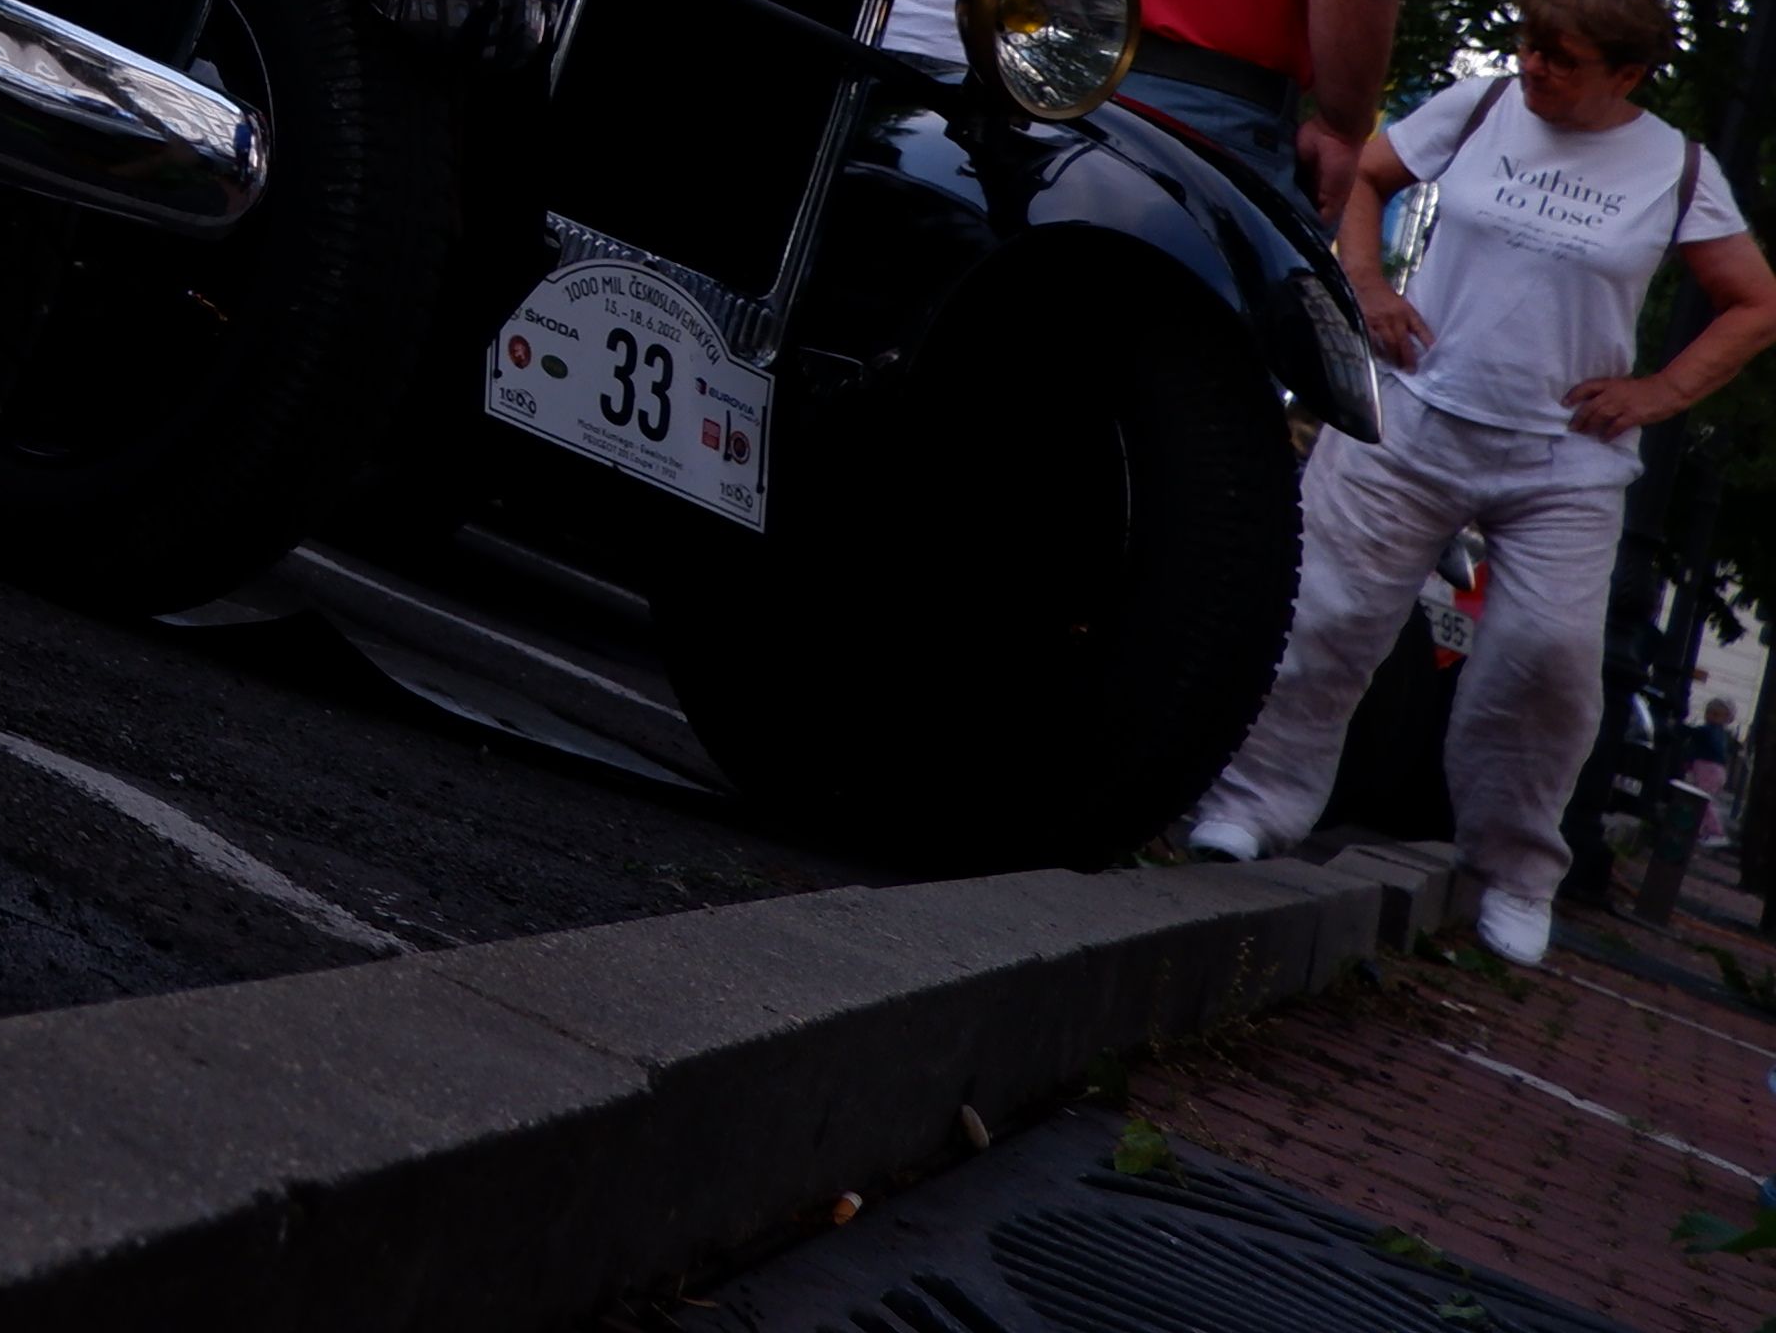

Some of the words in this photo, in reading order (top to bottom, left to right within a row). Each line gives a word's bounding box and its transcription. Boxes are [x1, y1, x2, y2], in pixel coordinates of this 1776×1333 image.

[1493, 155, 1626, 217] Nothing
[1495, 187, 1527, 209] to
[1537, 195, 1604, 230] lose
[564, 276, 599, 302] 1000
[601, 276, 625, 296] MIL
[524, 308, 580, 341] ŠKODA
[600, 327, 674, 442] 33
[708, 386, 755, 416] EUROVIA
